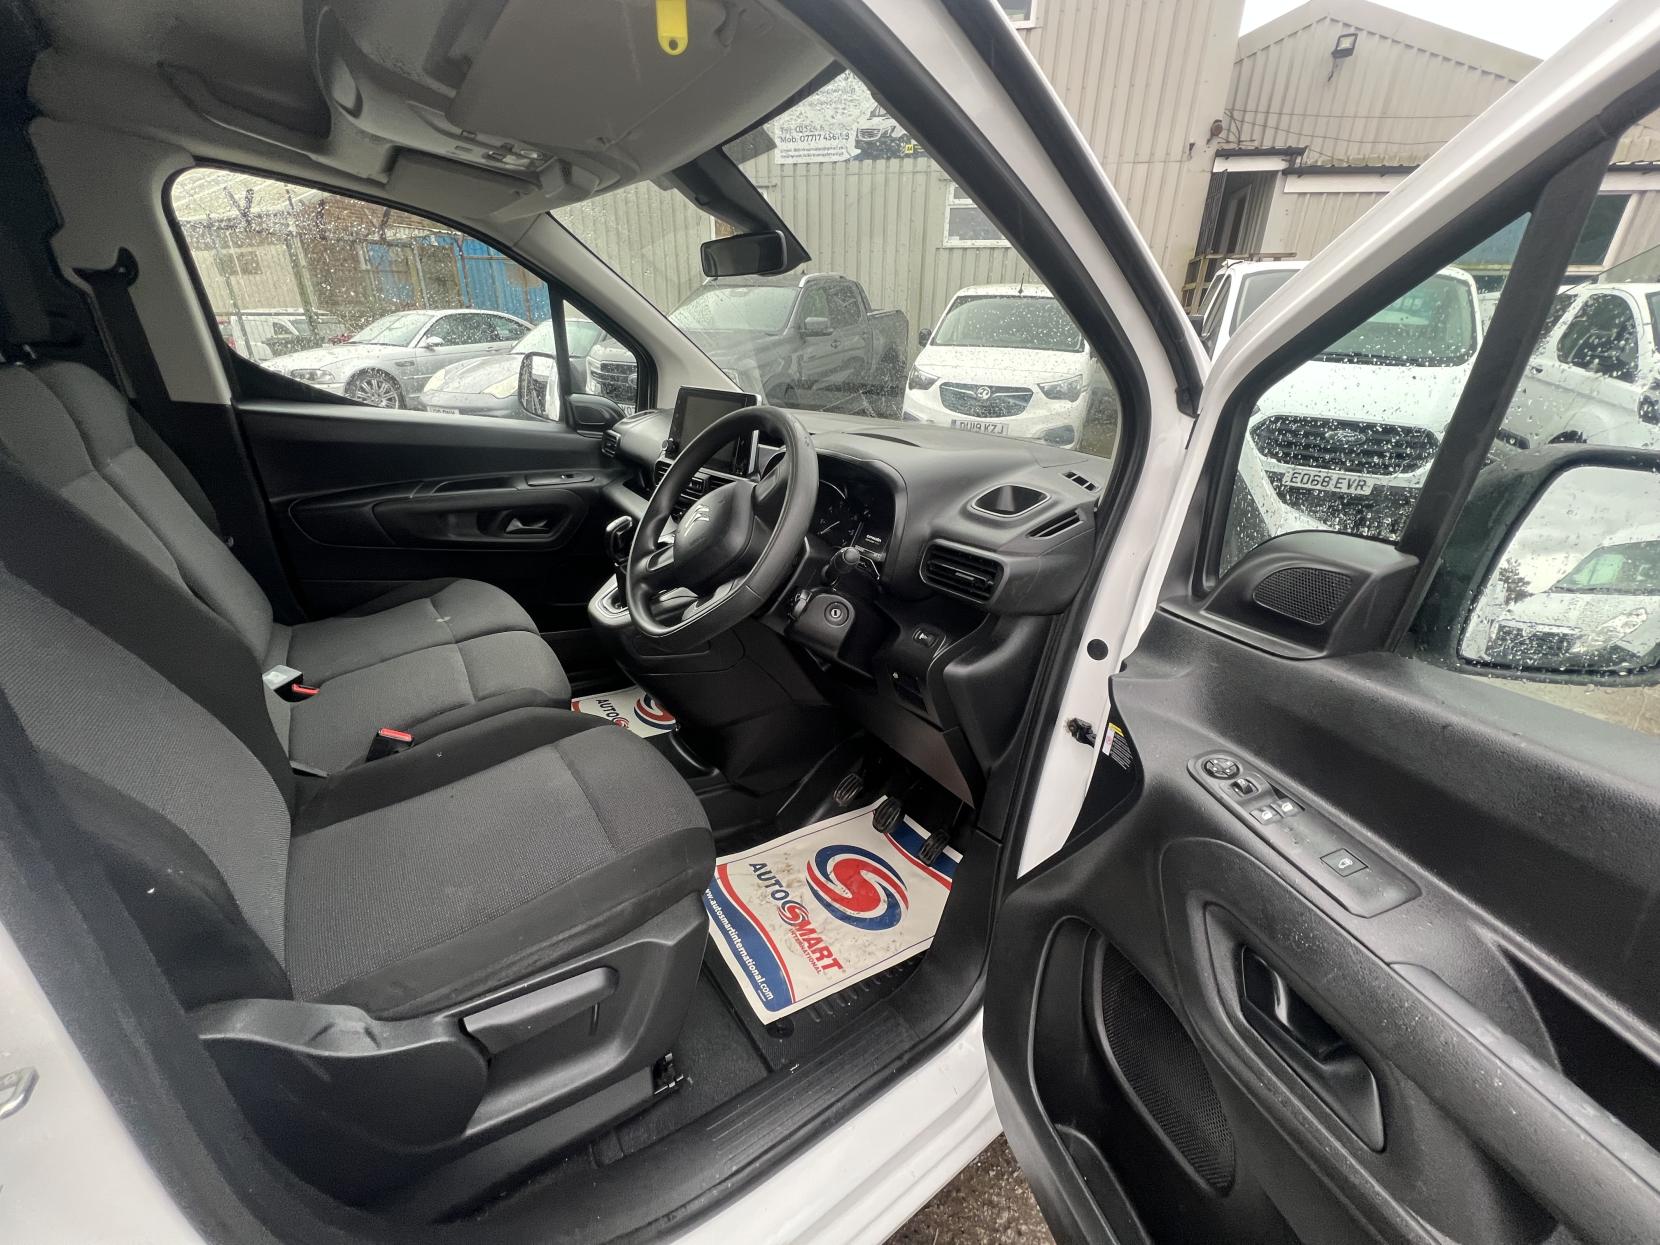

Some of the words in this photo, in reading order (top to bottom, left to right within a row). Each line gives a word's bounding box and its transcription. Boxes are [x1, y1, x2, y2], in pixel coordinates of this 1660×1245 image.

[800, 134, 821, 142] 07717
[984, 423, 1004, 435] KZJ
[1333, 477, 1368, 492] EVR
[789, 928, 821, 975] INTERNATIONAL
